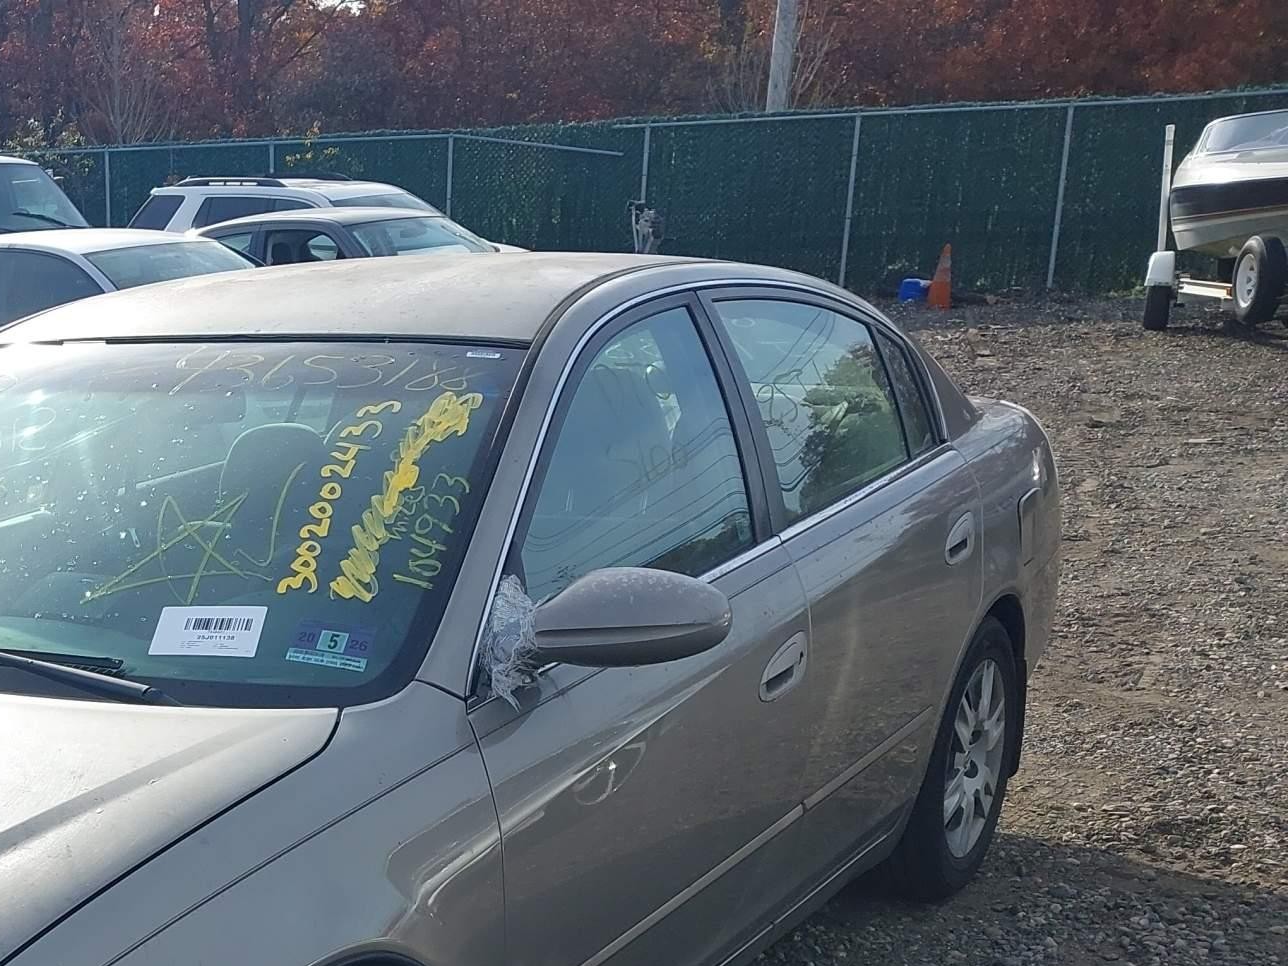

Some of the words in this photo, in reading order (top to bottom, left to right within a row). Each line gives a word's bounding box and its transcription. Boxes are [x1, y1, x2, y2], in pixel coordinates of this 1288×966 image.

[169, 346, 487, 396] 43653188
[276, 400, 402, 593] 3002002433
[392, 473, 470, 590] 104933
[298, 631, 316, 643] 20
[327, 633, 341, 650] 5
[349, 639, 369, 652] 26
